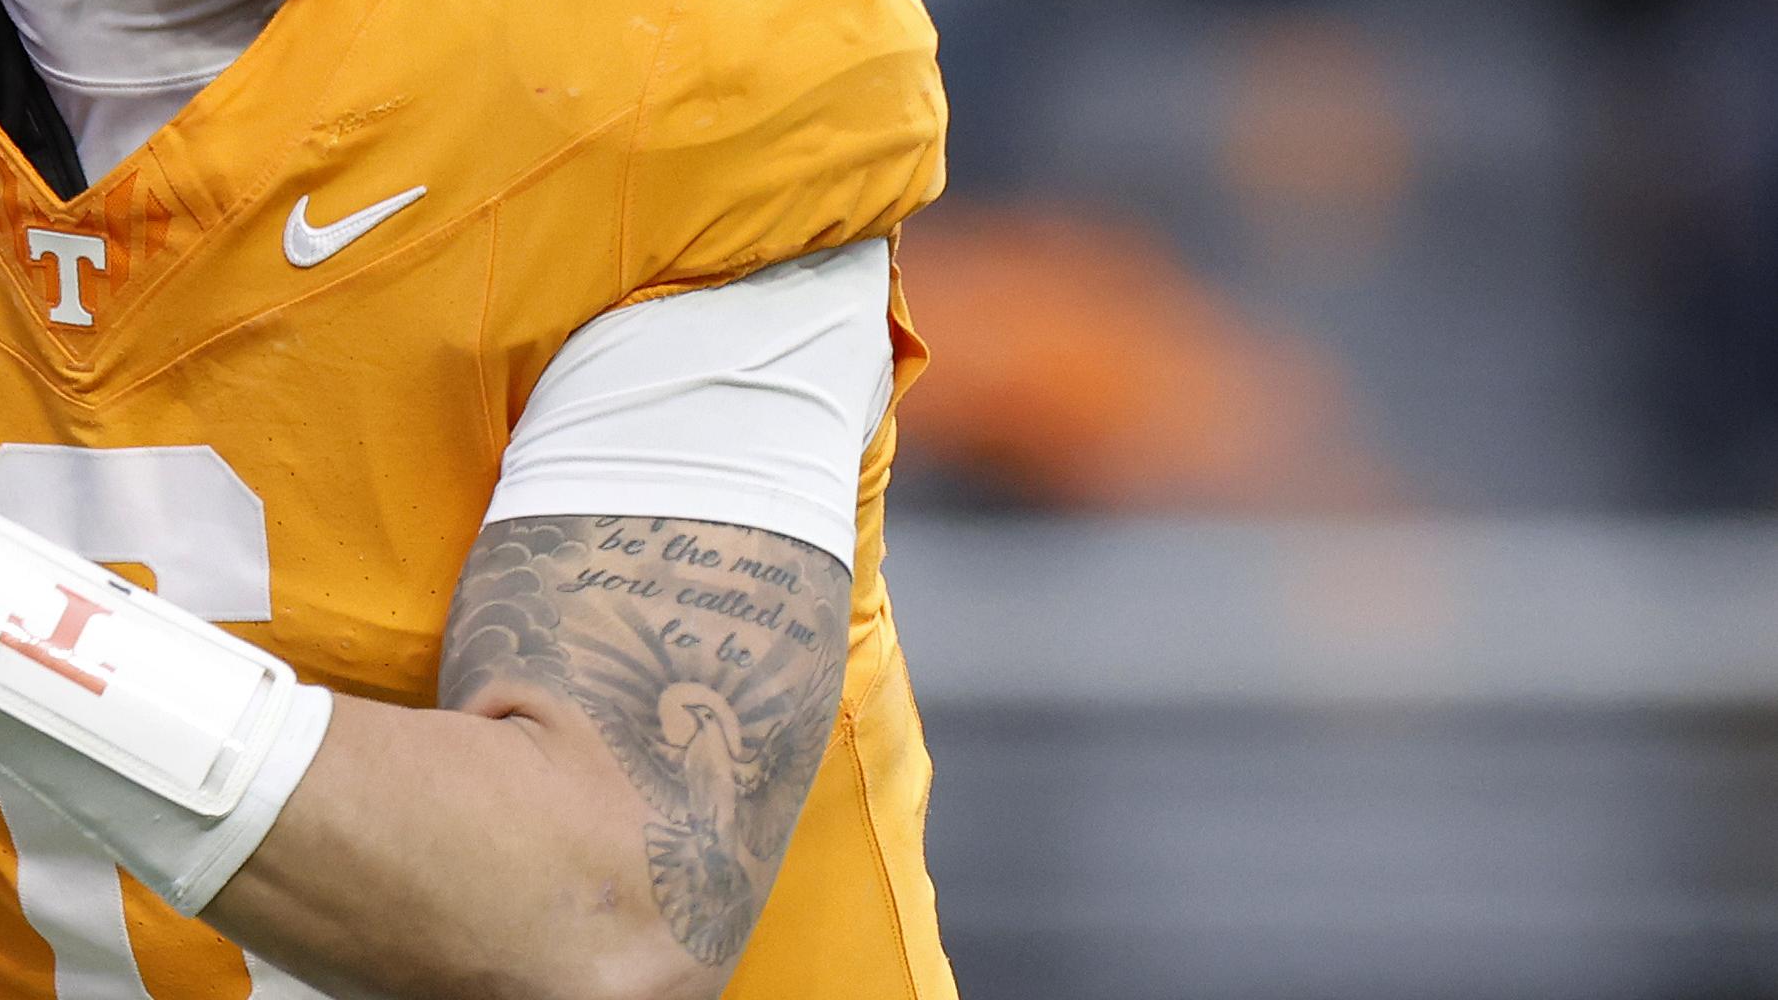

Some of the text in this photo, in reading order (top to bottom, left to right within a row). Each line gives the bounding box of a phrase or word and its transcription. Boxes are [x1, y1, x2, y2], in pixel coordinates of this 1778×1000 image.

[27, 227, 107, 327] T
[597, 527, 646, 556] be
[661, 533, 723, 569] the
[729, 555, 802, 595] man
[556, 567, 664, 599] you
[675, 586, 788, 630] called
[658, 618, 753, 668] to be
